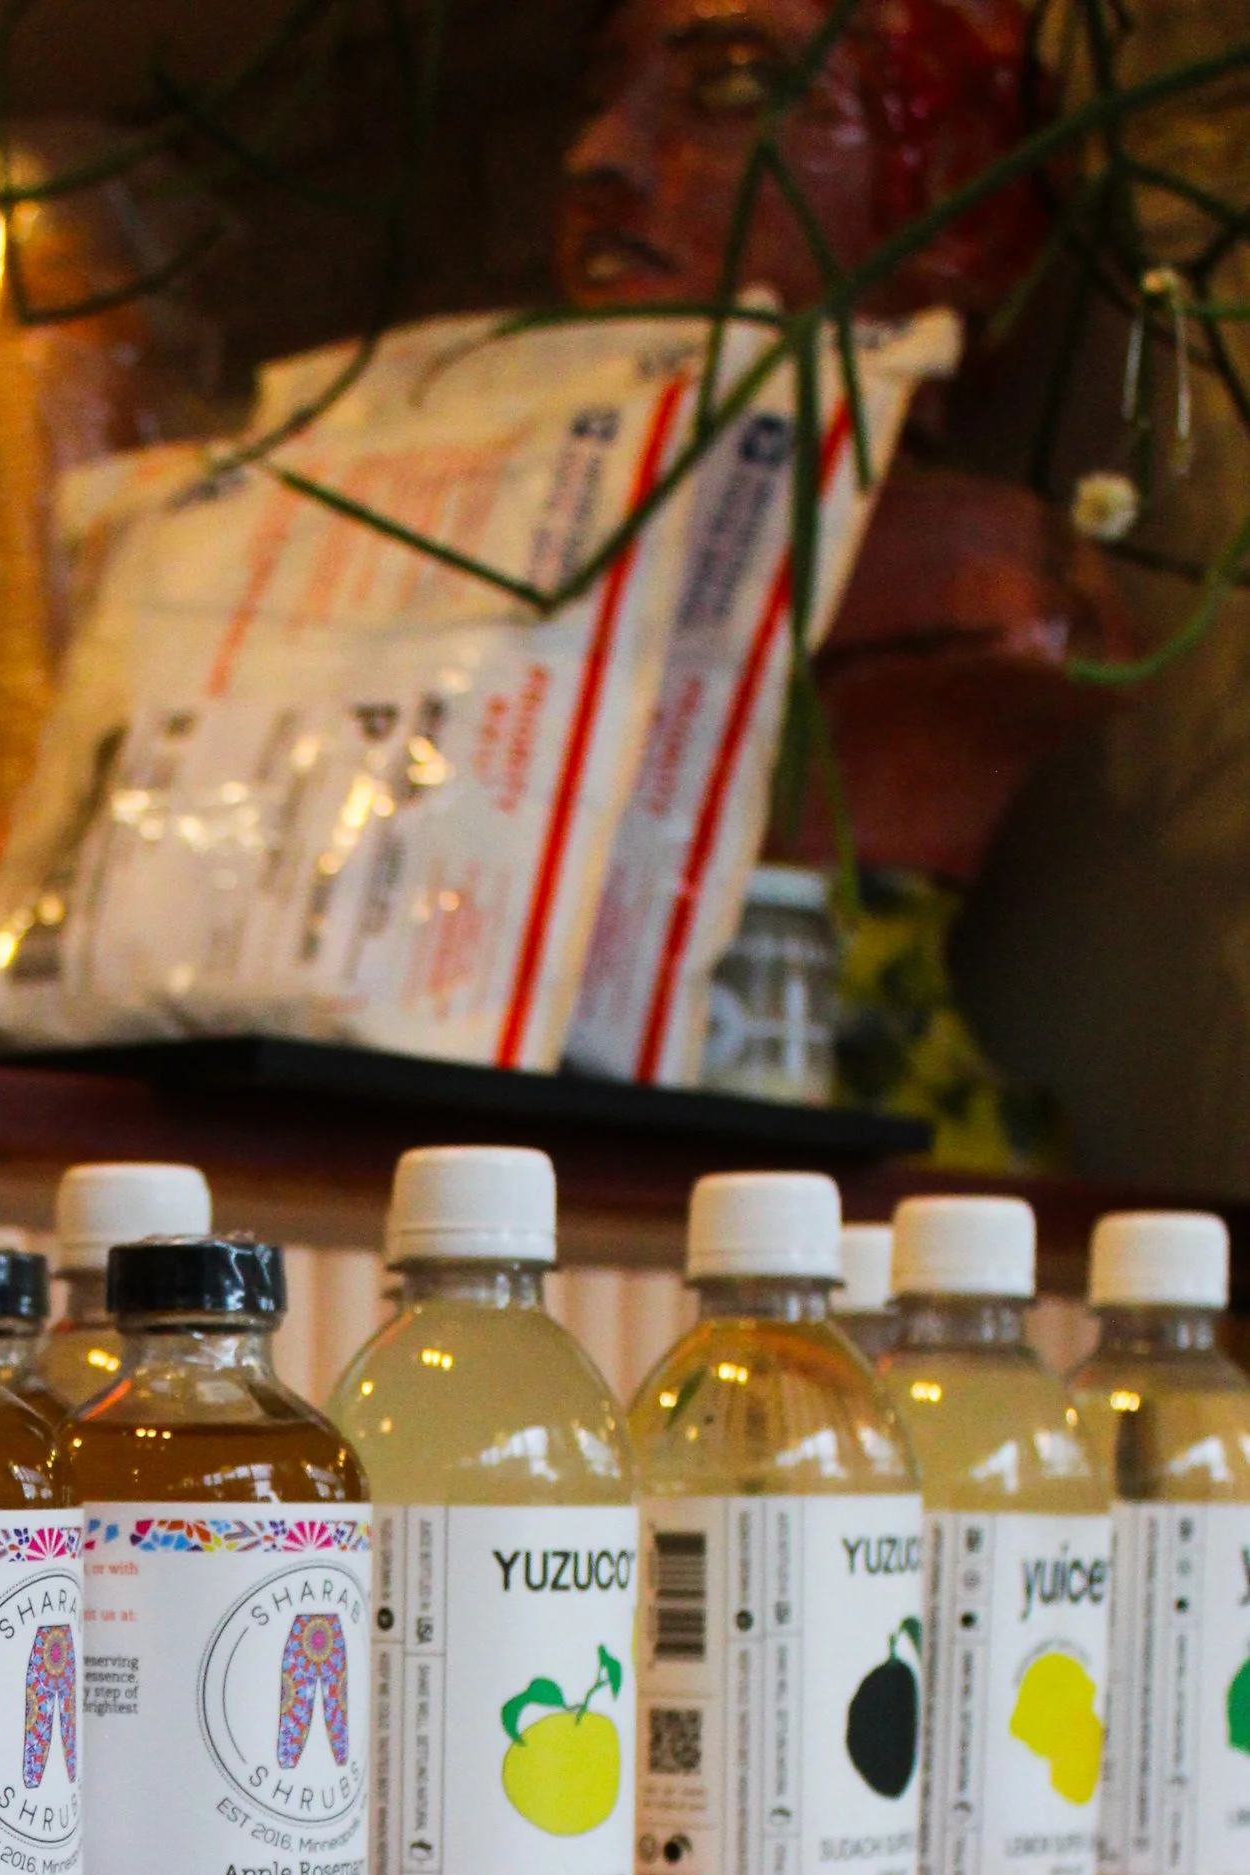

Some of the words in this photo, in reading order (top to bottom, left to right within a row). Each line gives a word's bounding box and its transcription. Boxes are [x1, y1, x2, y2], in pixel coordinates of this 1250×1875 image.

[108, 1562, 139, 1575] with
[492, 1549, 631, 1592] YUZUCO
[1019, 1542, 1107, 1621] yuice
[251, 1580, 360, 1625] SHARAB
[94, 1686, 121, 1700] step
[125, 1686, 138, 1699] of
[249, 1760, 359, 1812] SHRUBS
[216, 1797, 251, 1828] EST
